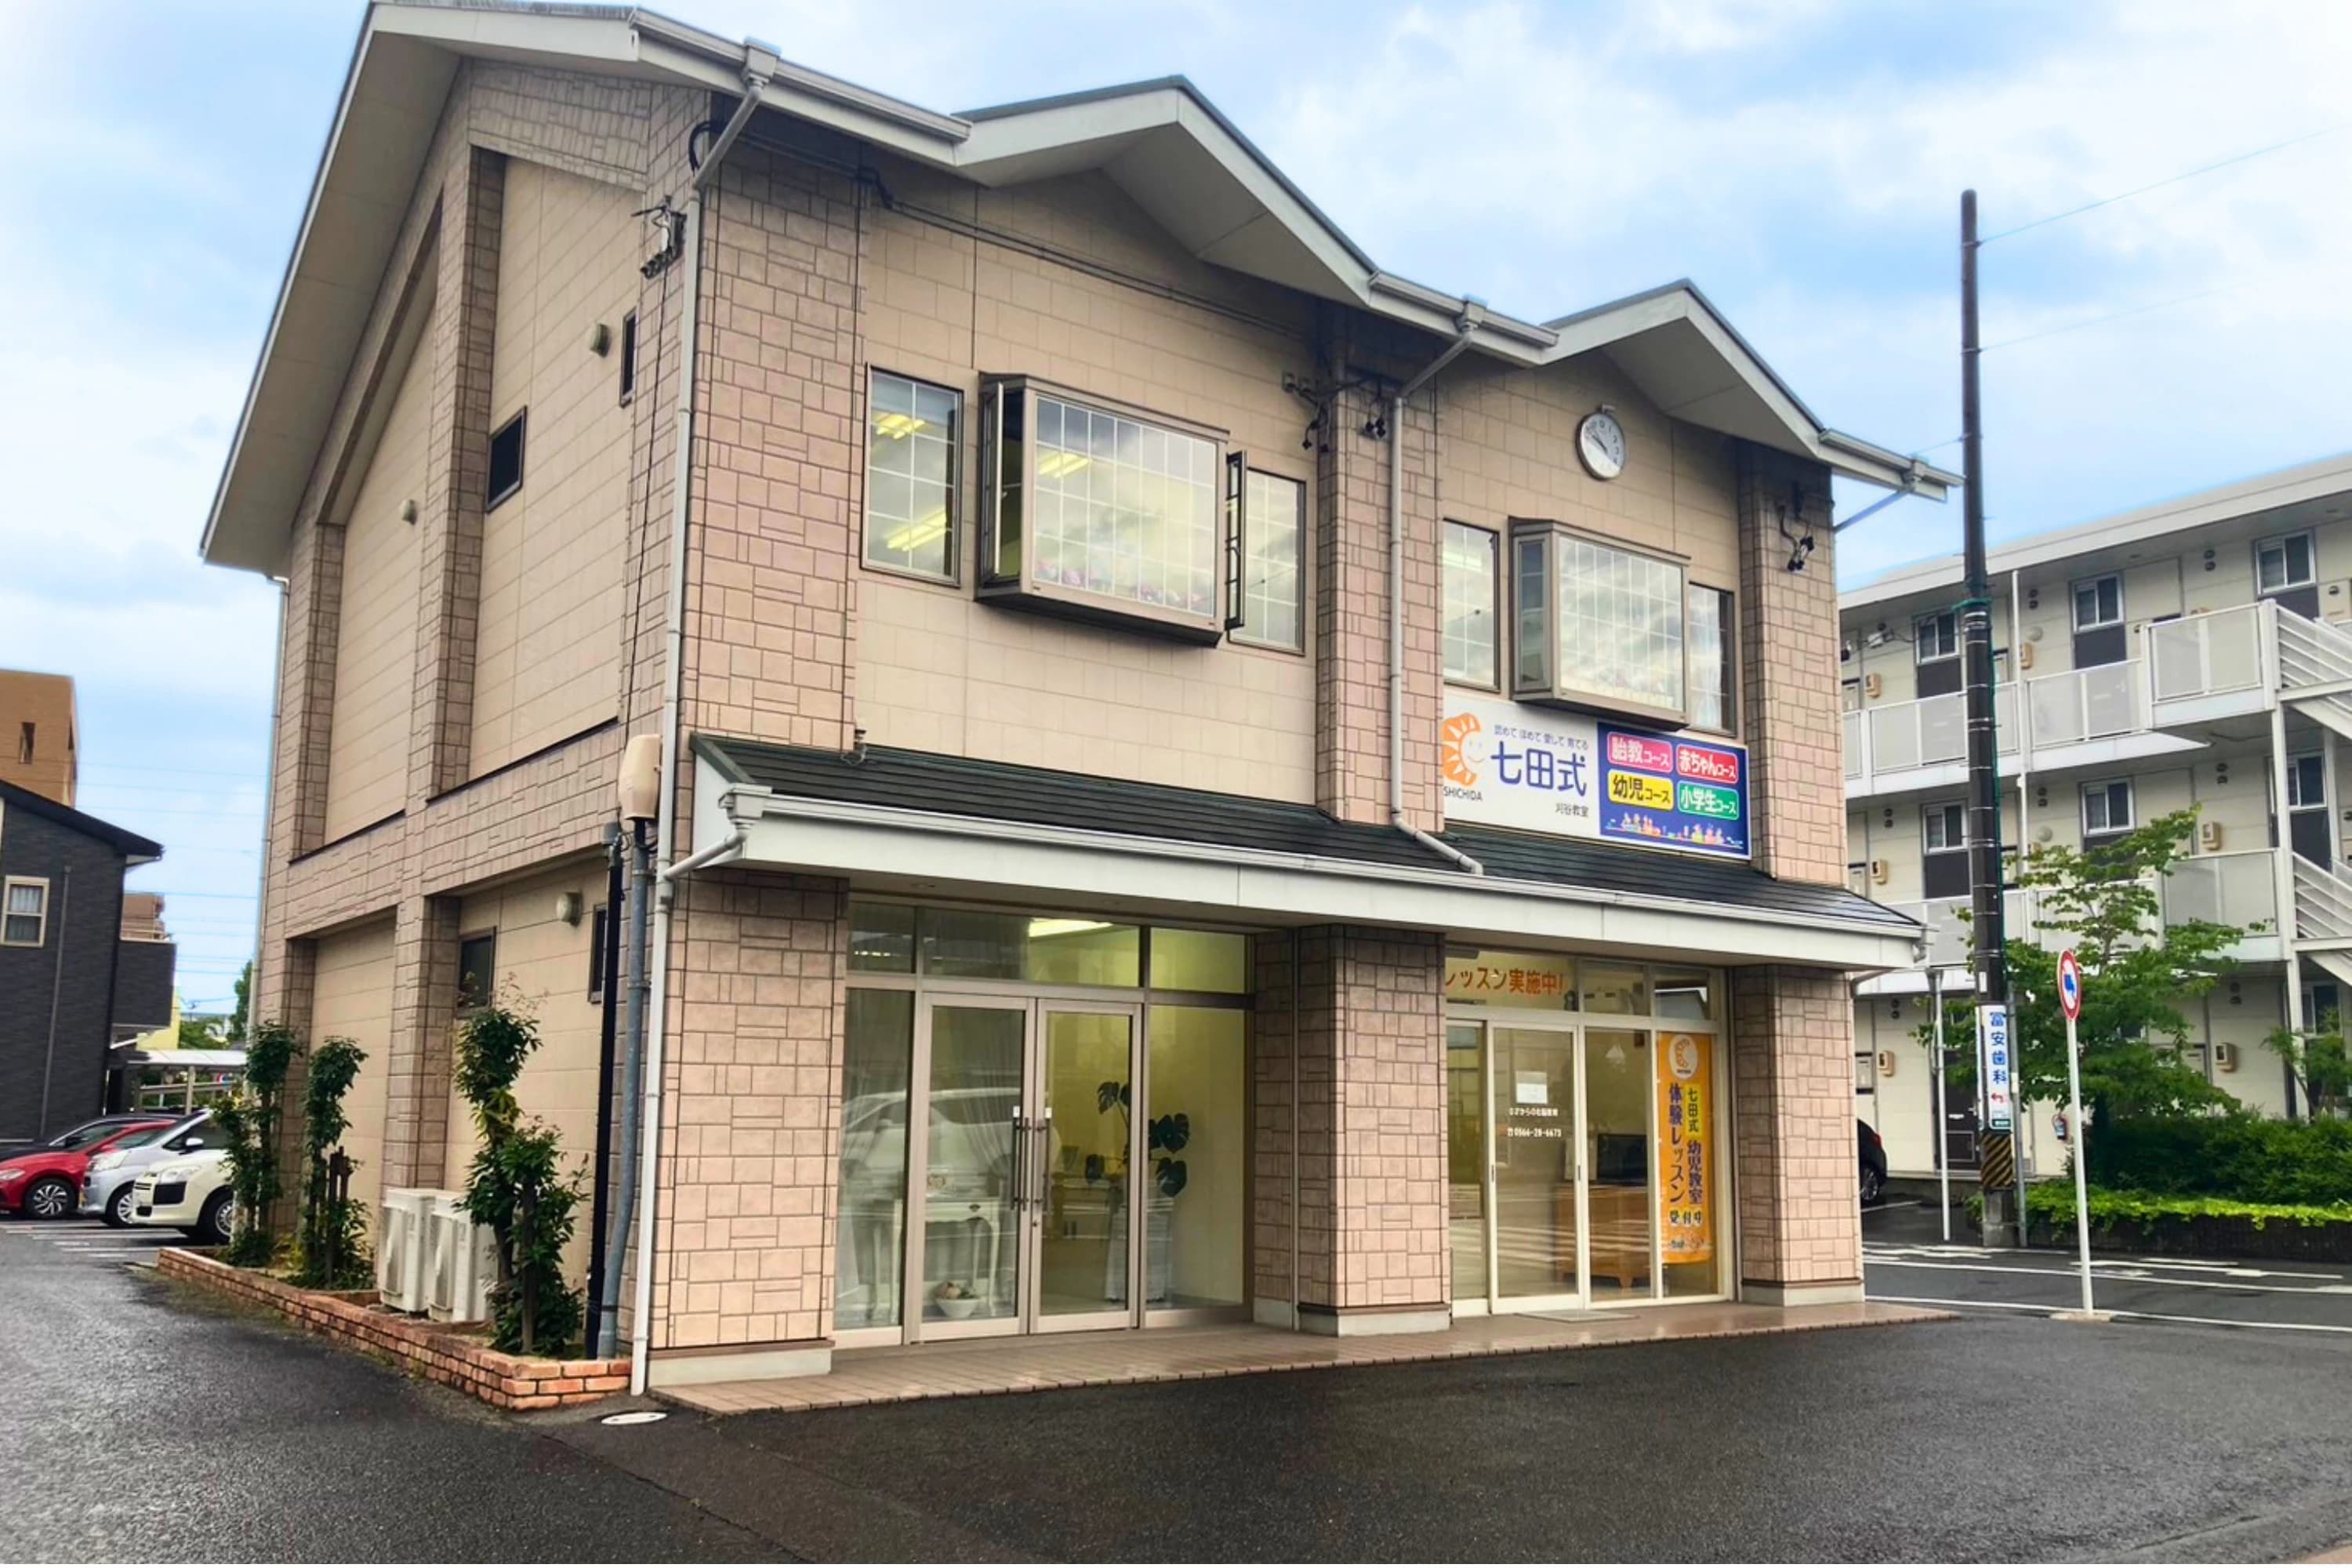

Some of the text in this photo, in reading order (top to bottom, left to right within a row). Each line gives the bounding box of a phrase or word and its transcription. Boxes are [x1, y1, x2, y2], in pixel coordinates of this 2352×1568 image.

[1611, 736, 1669, 767] 胎教コース
[1679, 749, 1736, 779] 赤ちゃんコース
[1490, 740, 1588, 797] 七田式
[1443, 786, 1483, 801] SHICHIDA
[1613, 774, 1671, 804] 幼児コース
[1681, 786, 1737, 815] 小学生コース
[1688, 1087, 1699, 1133] 七田式
[1669, 1083, 1685, 1203] 体験レッスン
